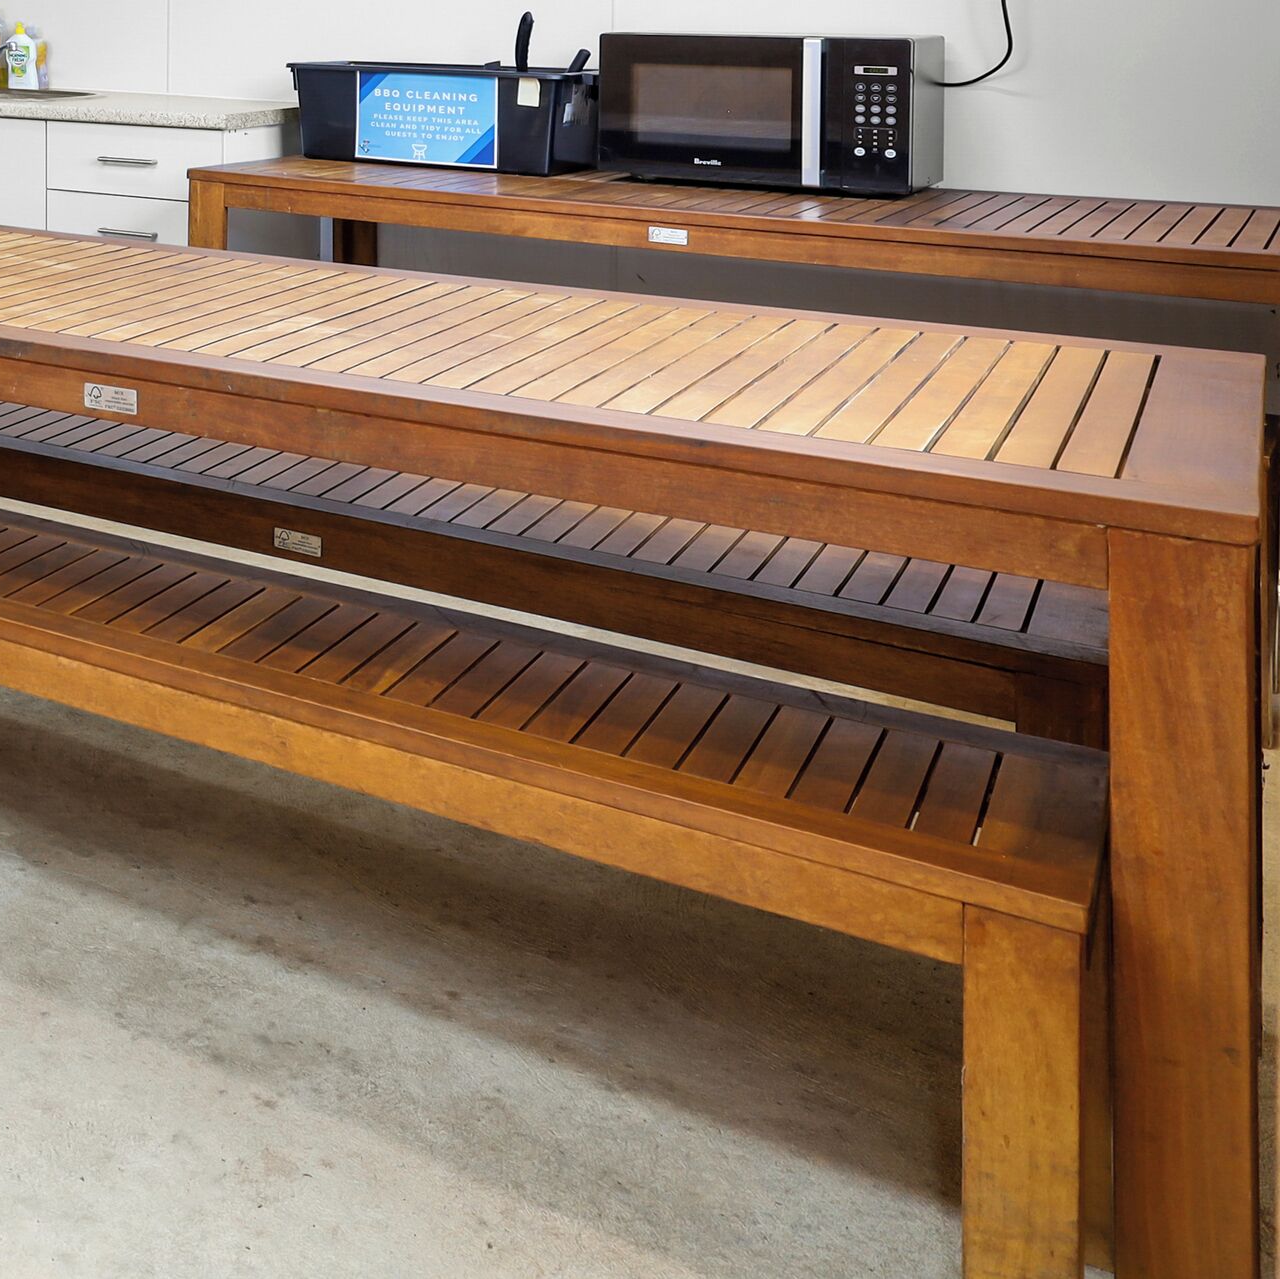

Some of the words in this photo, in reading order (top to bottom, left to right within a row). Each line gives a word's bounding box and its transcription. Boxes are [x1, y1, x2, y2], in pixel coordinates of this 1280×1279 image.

[374, 88, 400, 98] BBQ
[406, 90, 478, 102] CLEANING
[385, 102, 466, 115] EQUIPMENT
[373, 113, 403, 121] PLEASE
[431, 116, 452, 124] THIS
[370, 121, 397, 129] CLEAN
[421, 124, 441, 132] TIDY
[385, 130, 418, 138] GUESTS
[435, 134, 465, 142] ENJOY
